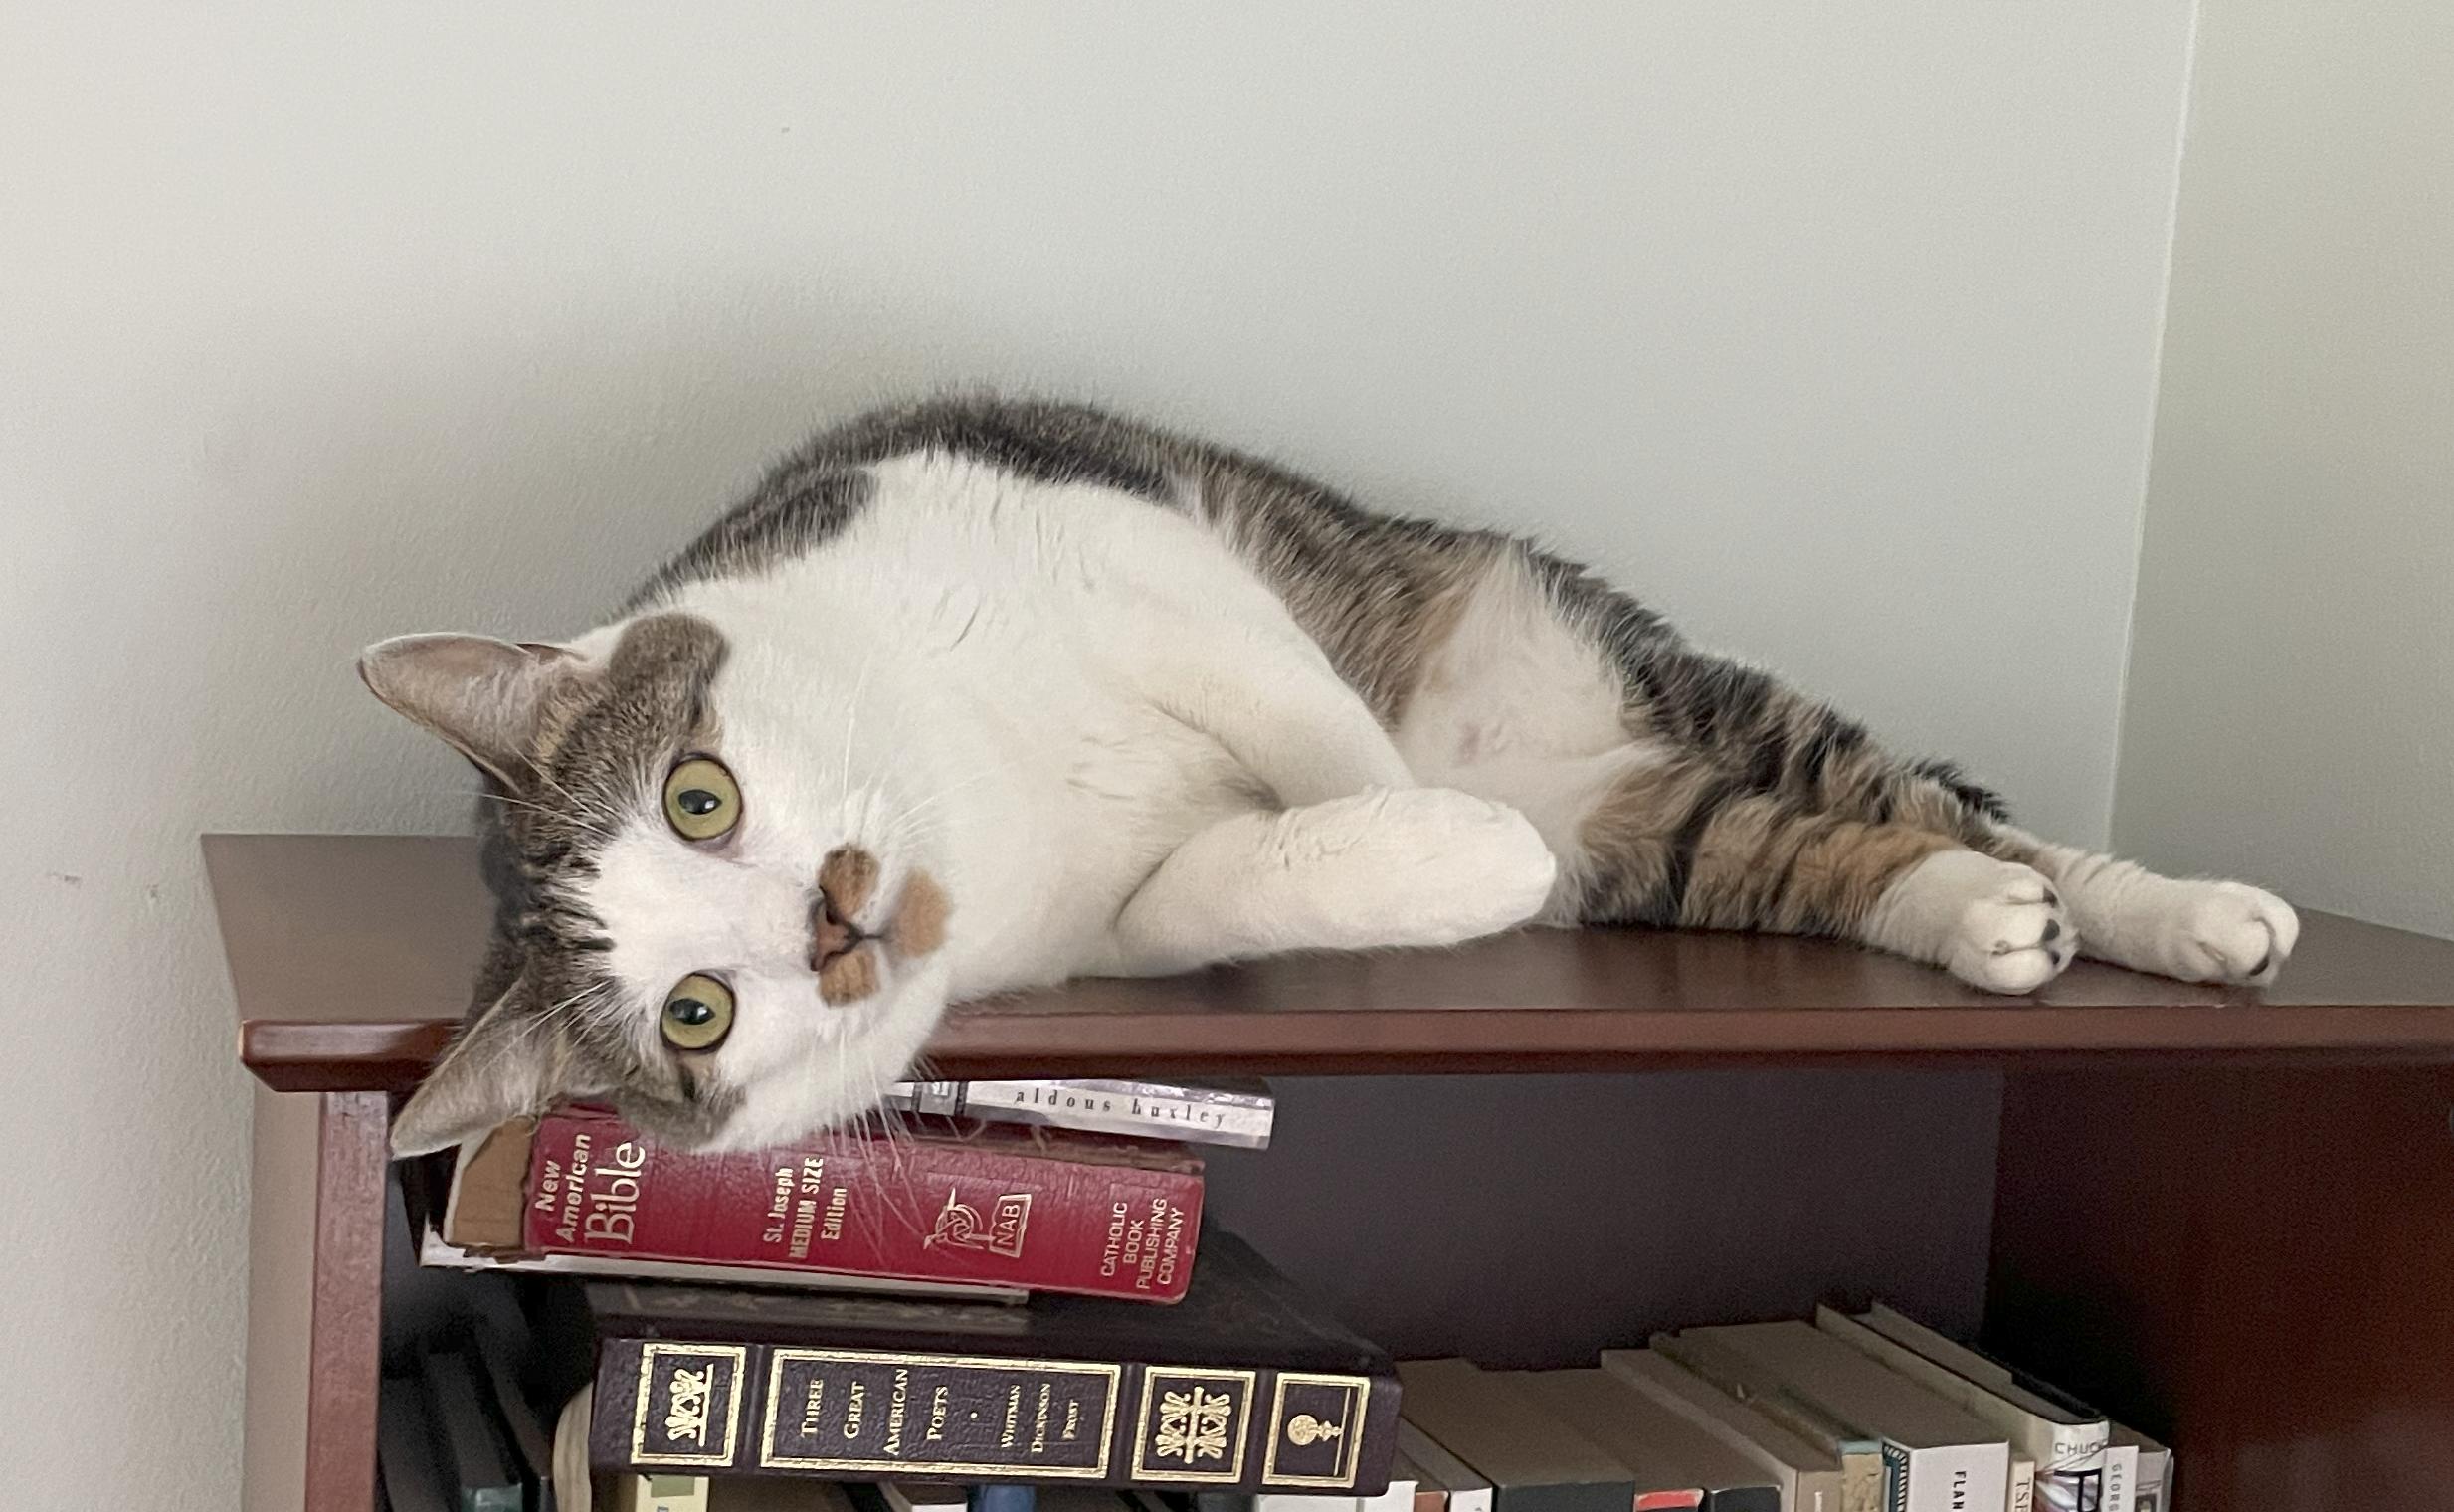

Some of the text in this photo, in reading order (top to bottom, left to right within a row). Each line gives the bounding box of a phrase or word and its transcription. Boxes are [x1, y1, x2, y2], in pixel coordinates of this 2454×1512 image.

[1016, 1088, 1225, 1128] aldous huxley
[535, 1160, 561, 1211] New
[555, 1134, 592, 1243] American
[583, 1142, 646, 1244] Bible
[767, 1168, 795, 1219] Joseph
[788, 1157, 824, 1258] MEDIUM SIZE
[820, 1188, 848, 1240] Edition
[997, 1204, 1021, 1247] NAB
[1100, 1202, 1128, 1277] CATHOLIC
[1122, 1220, 1144, 1264] BOOK
[1135, 1198, 1168, 1290] PUBLISHING
[1156, 1207, 1185, 1285] COMPANY
[800, 1379, 824, 1438] THREE
[844, 1381, 865, 1439] GREAT
[883, 1368, 908, 1456] AMERICAN
[926, 1386, 949, 1441] POETS
[1000, 1384, 1021, 1448] WHITMAN
[1030, 1383, 1051, 1453] DICKINSON
[1061, 1399, 1079, 1441] FROST
